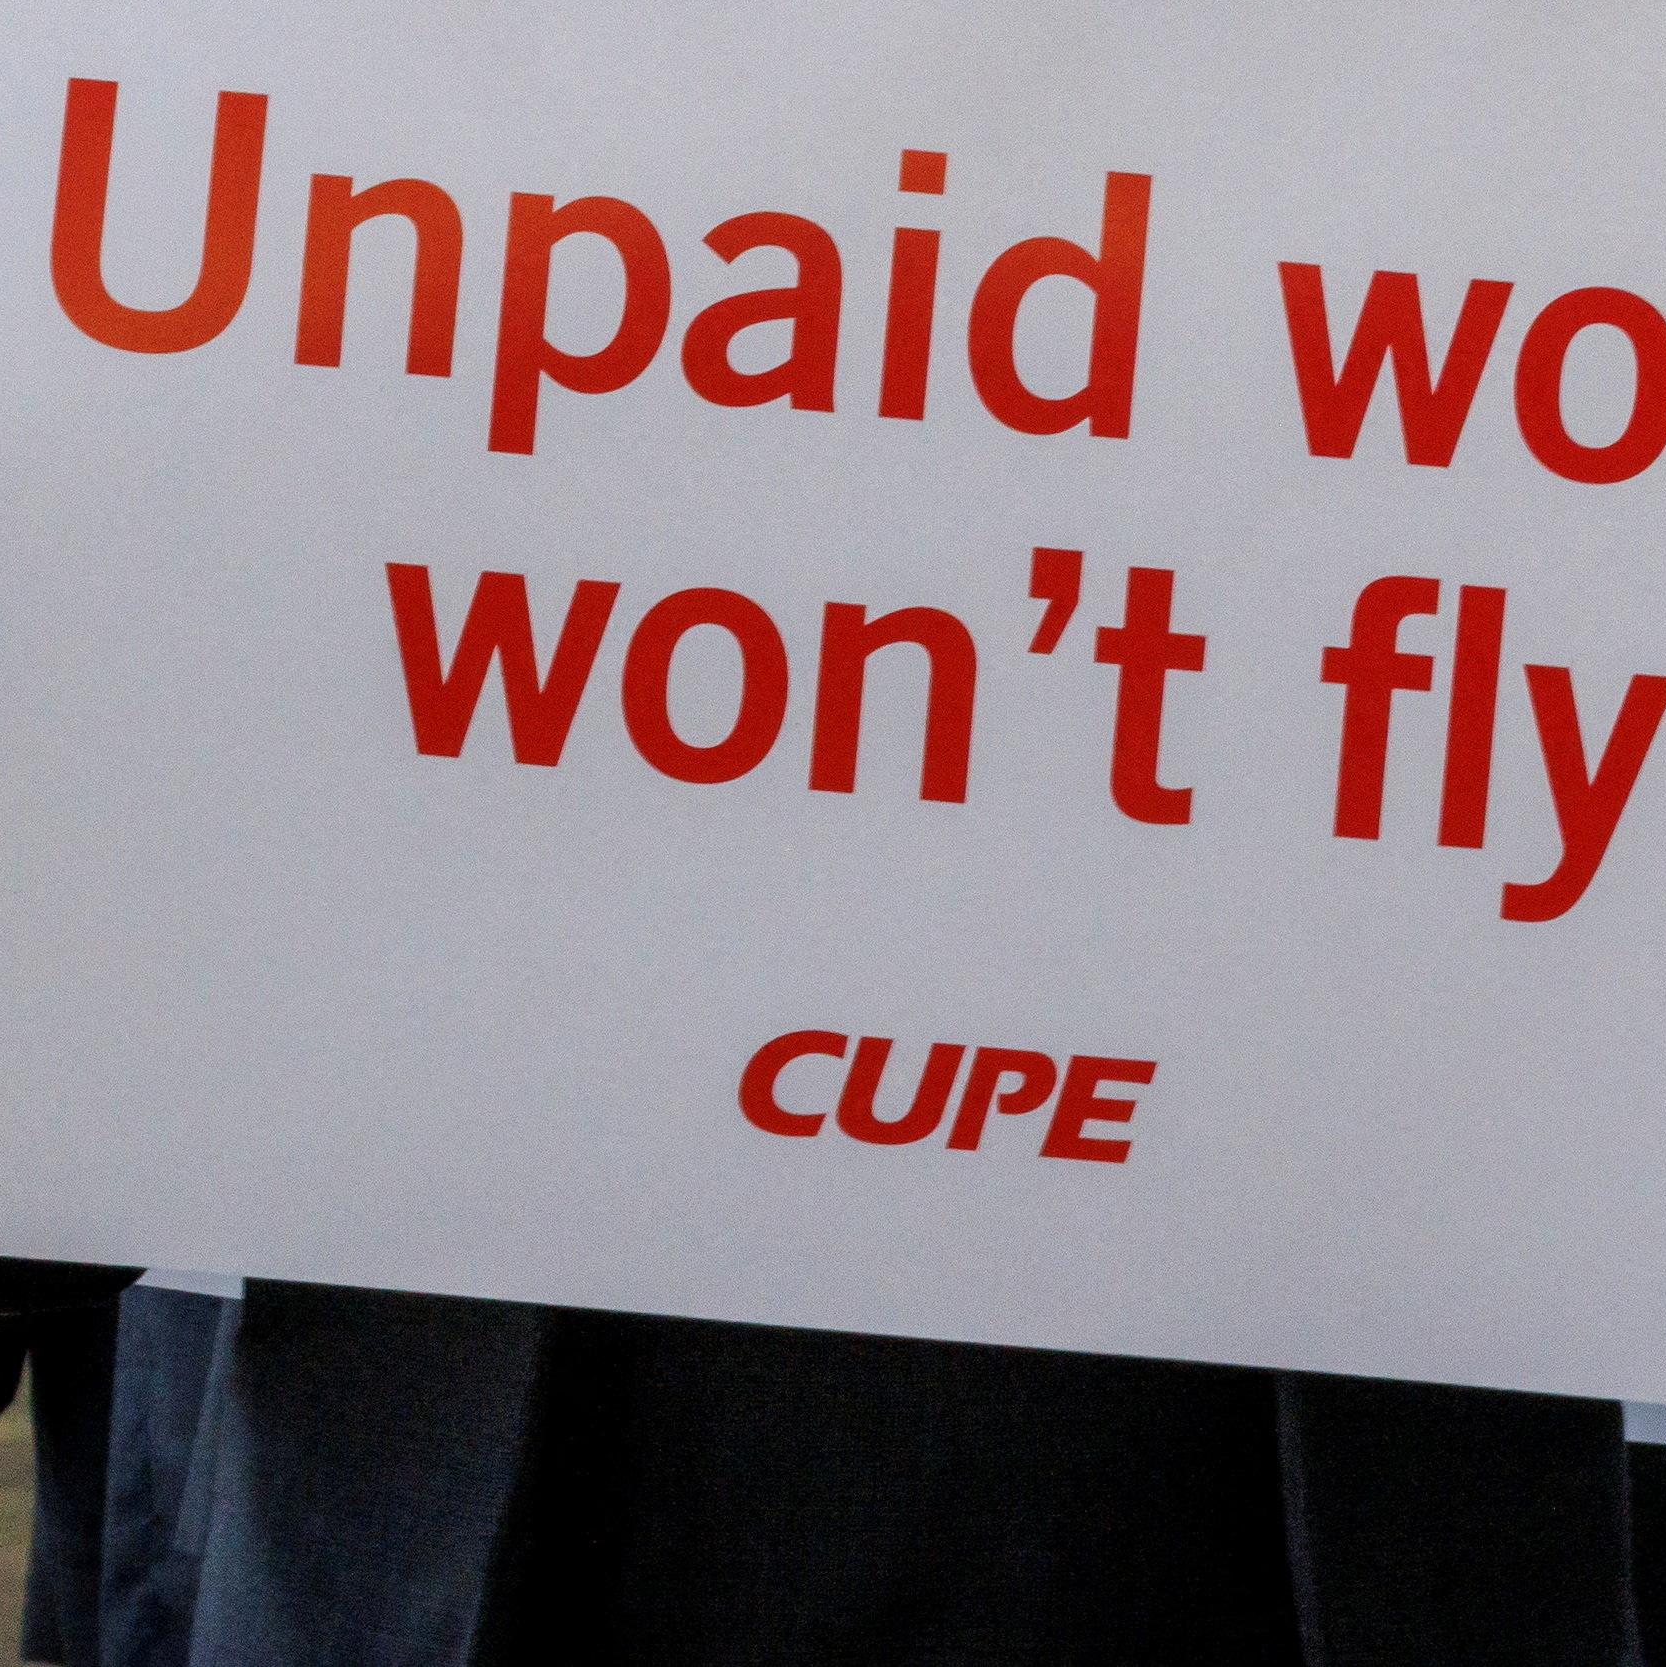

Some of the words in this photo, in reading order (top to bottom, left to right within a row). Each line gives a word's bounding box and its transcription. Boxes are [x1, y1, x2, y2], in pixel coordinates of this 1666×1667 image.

[49, 77, 1153, 456] Unpaid
[385, 546, 1207, 826] won't
[738, 1029, 1158, 1164] CUPE
